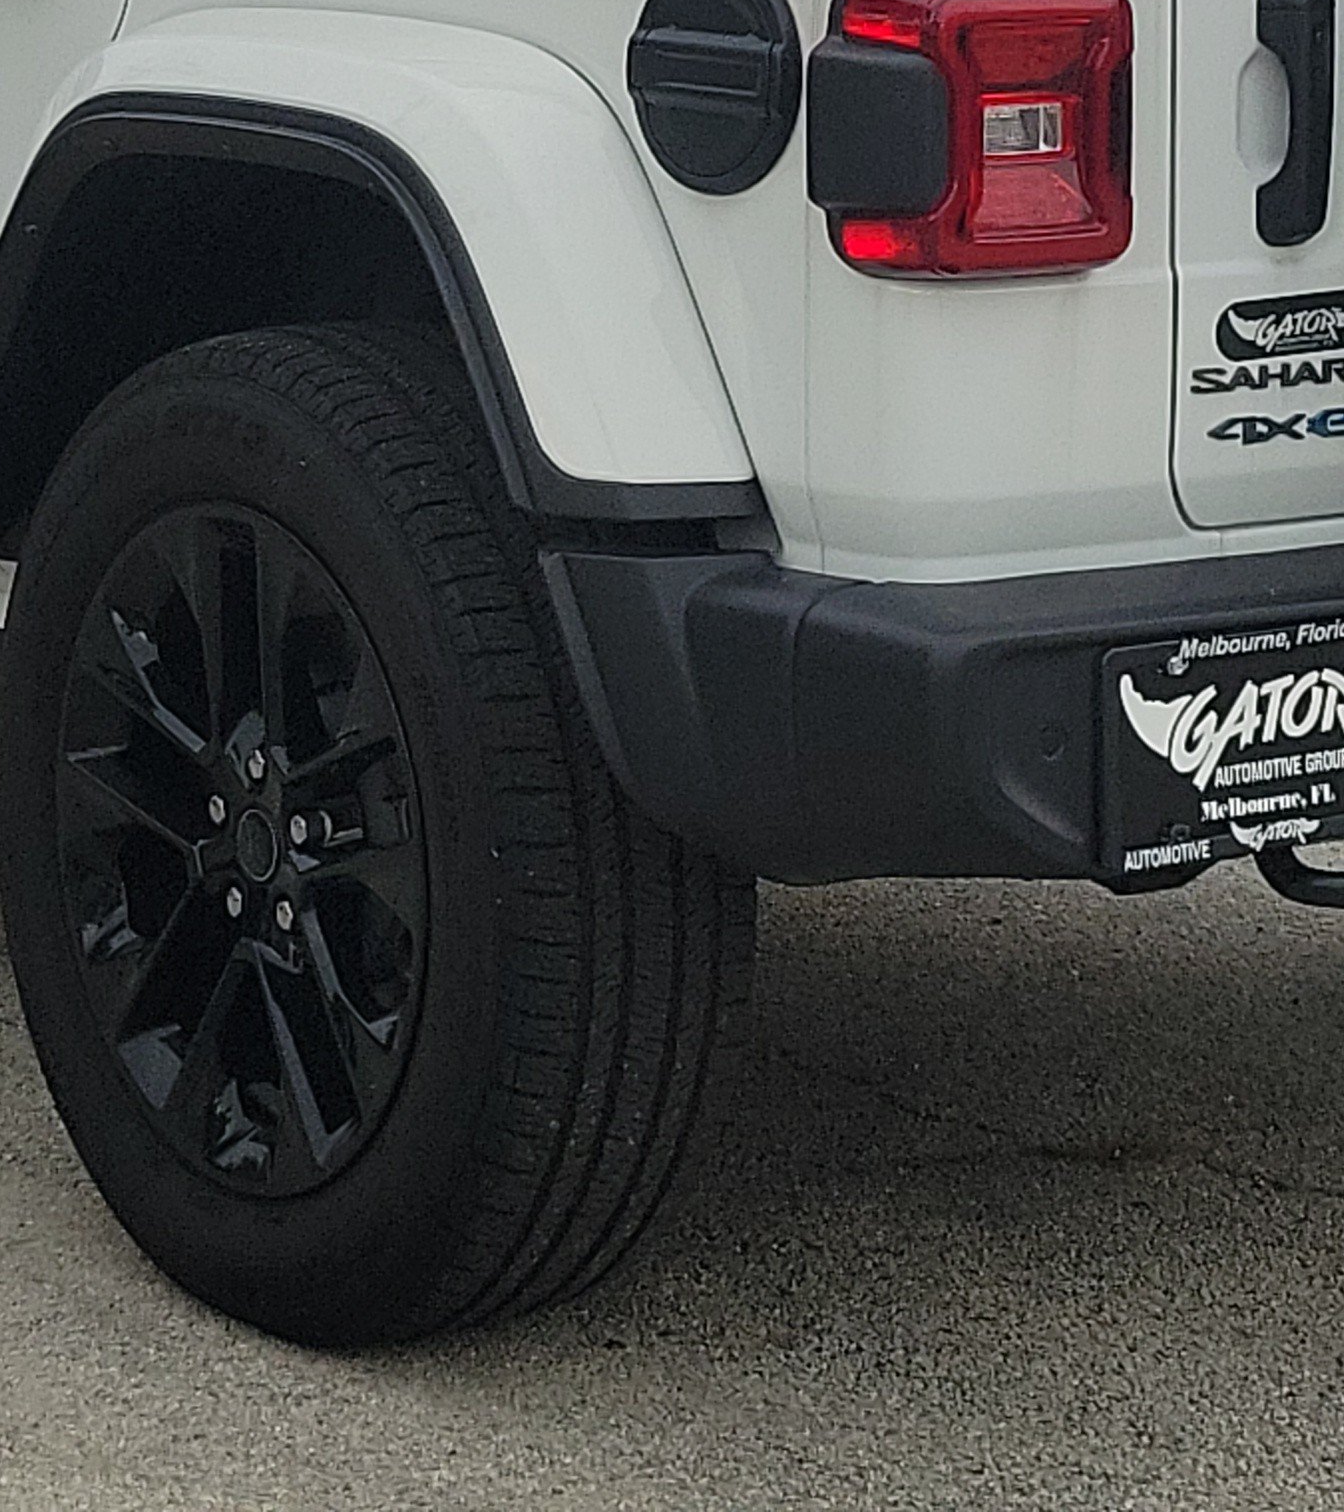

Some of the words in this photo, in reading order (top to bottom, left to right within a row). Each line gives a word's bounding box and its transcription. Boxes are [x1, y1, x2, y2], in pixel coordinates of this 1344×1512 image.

[1256, 307, 1339, 353] GATOR
[1176, 632, 1291, 662] Melbourne,
[1214, 754, 1303, 788] AUTOMOTIVE
[1200, 791, 1308, 822] Melbourne,
[1310, 783, 1336, 805] FL
[1124, 839, 1212, 873] AUTOMOTIVE
[1250, 818, 1307, 852] GATOR
